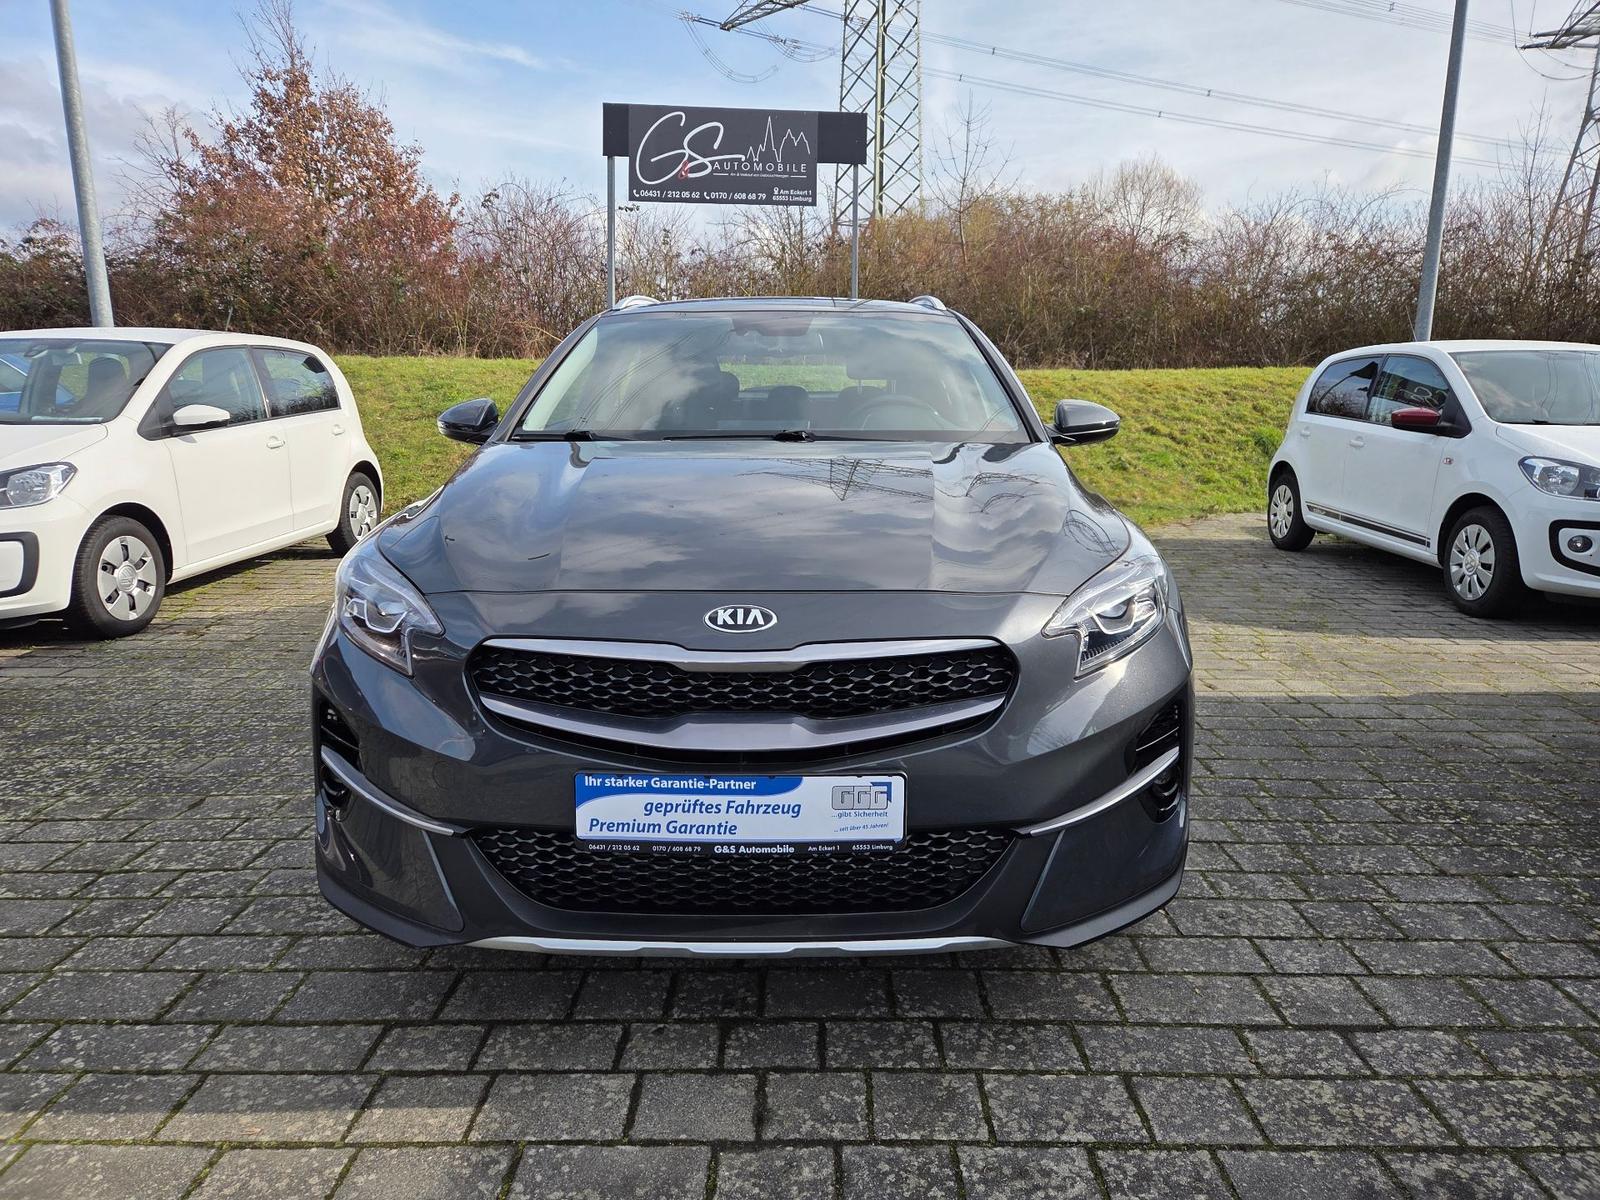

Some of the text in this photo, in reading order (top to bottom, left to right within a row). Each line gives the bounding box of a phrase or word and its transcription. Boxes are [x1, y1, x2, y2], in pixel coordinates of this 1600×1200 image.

[713, 162, 807, 172] AUTOMOBILE
[717, 608, 764, 625] KIA
[584, 776, 756, 790] Ihr starker Garantie-Partner
[644, 799, 801, 818] geprüftes Fahrzeug
[589, 818, 737, 835] Premium Garantie
[739, 845, 795, 853] Automobile
